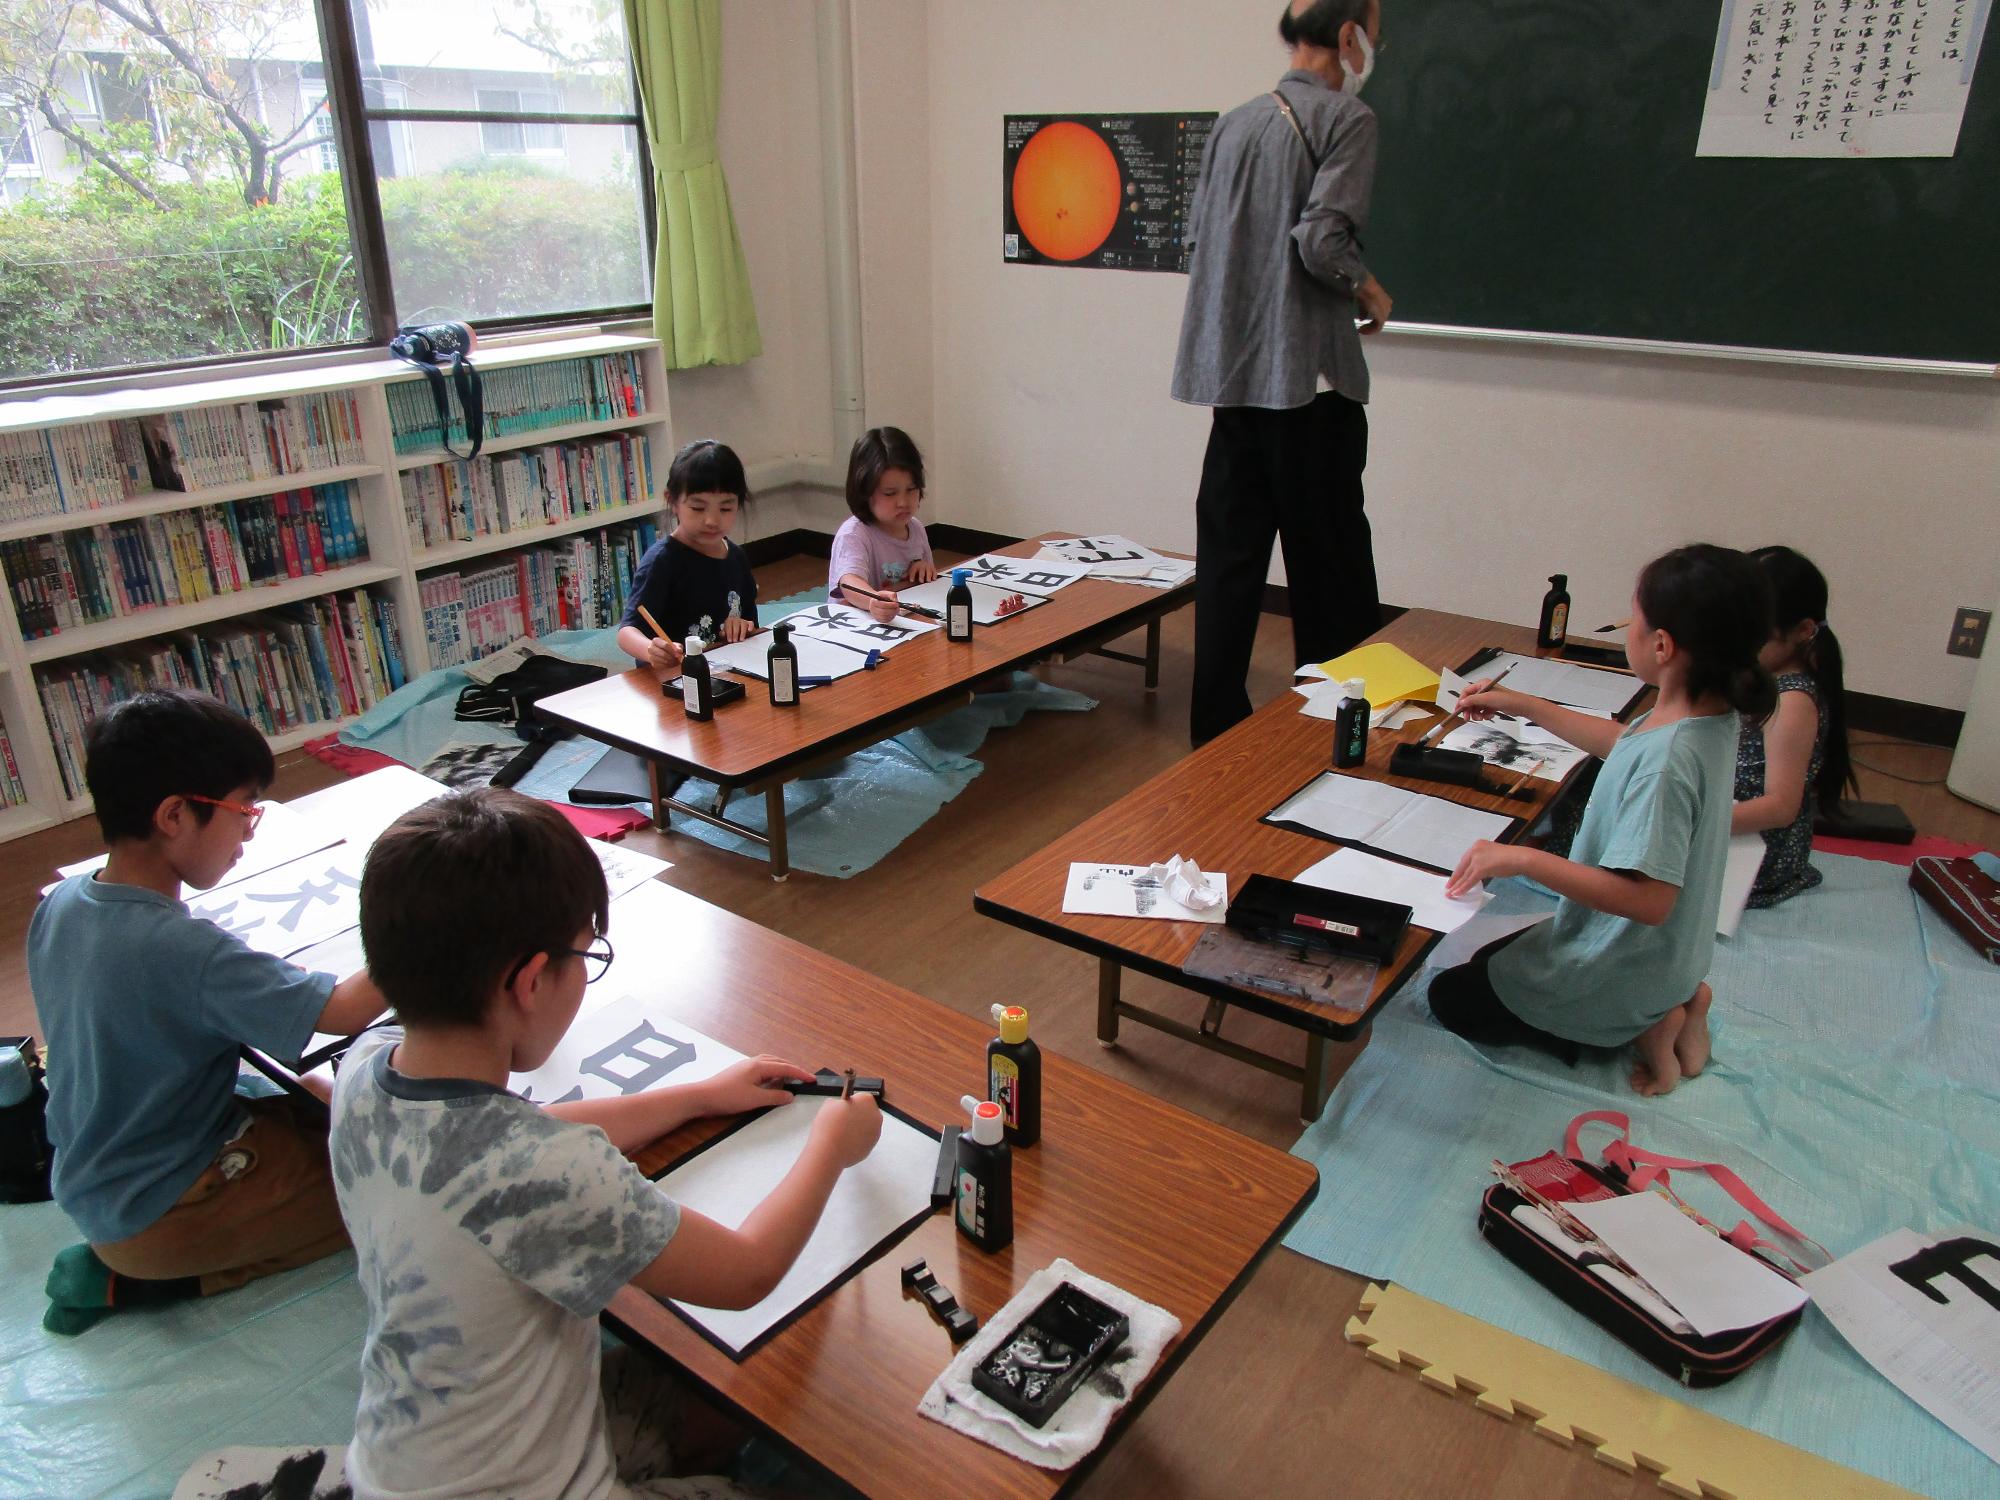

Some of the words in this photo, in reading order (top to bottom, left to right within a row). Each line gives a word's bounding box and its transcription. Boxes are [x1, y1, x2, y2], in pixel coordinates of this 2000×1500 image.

[1740, 3, 1767, 93] 元気に大きく
